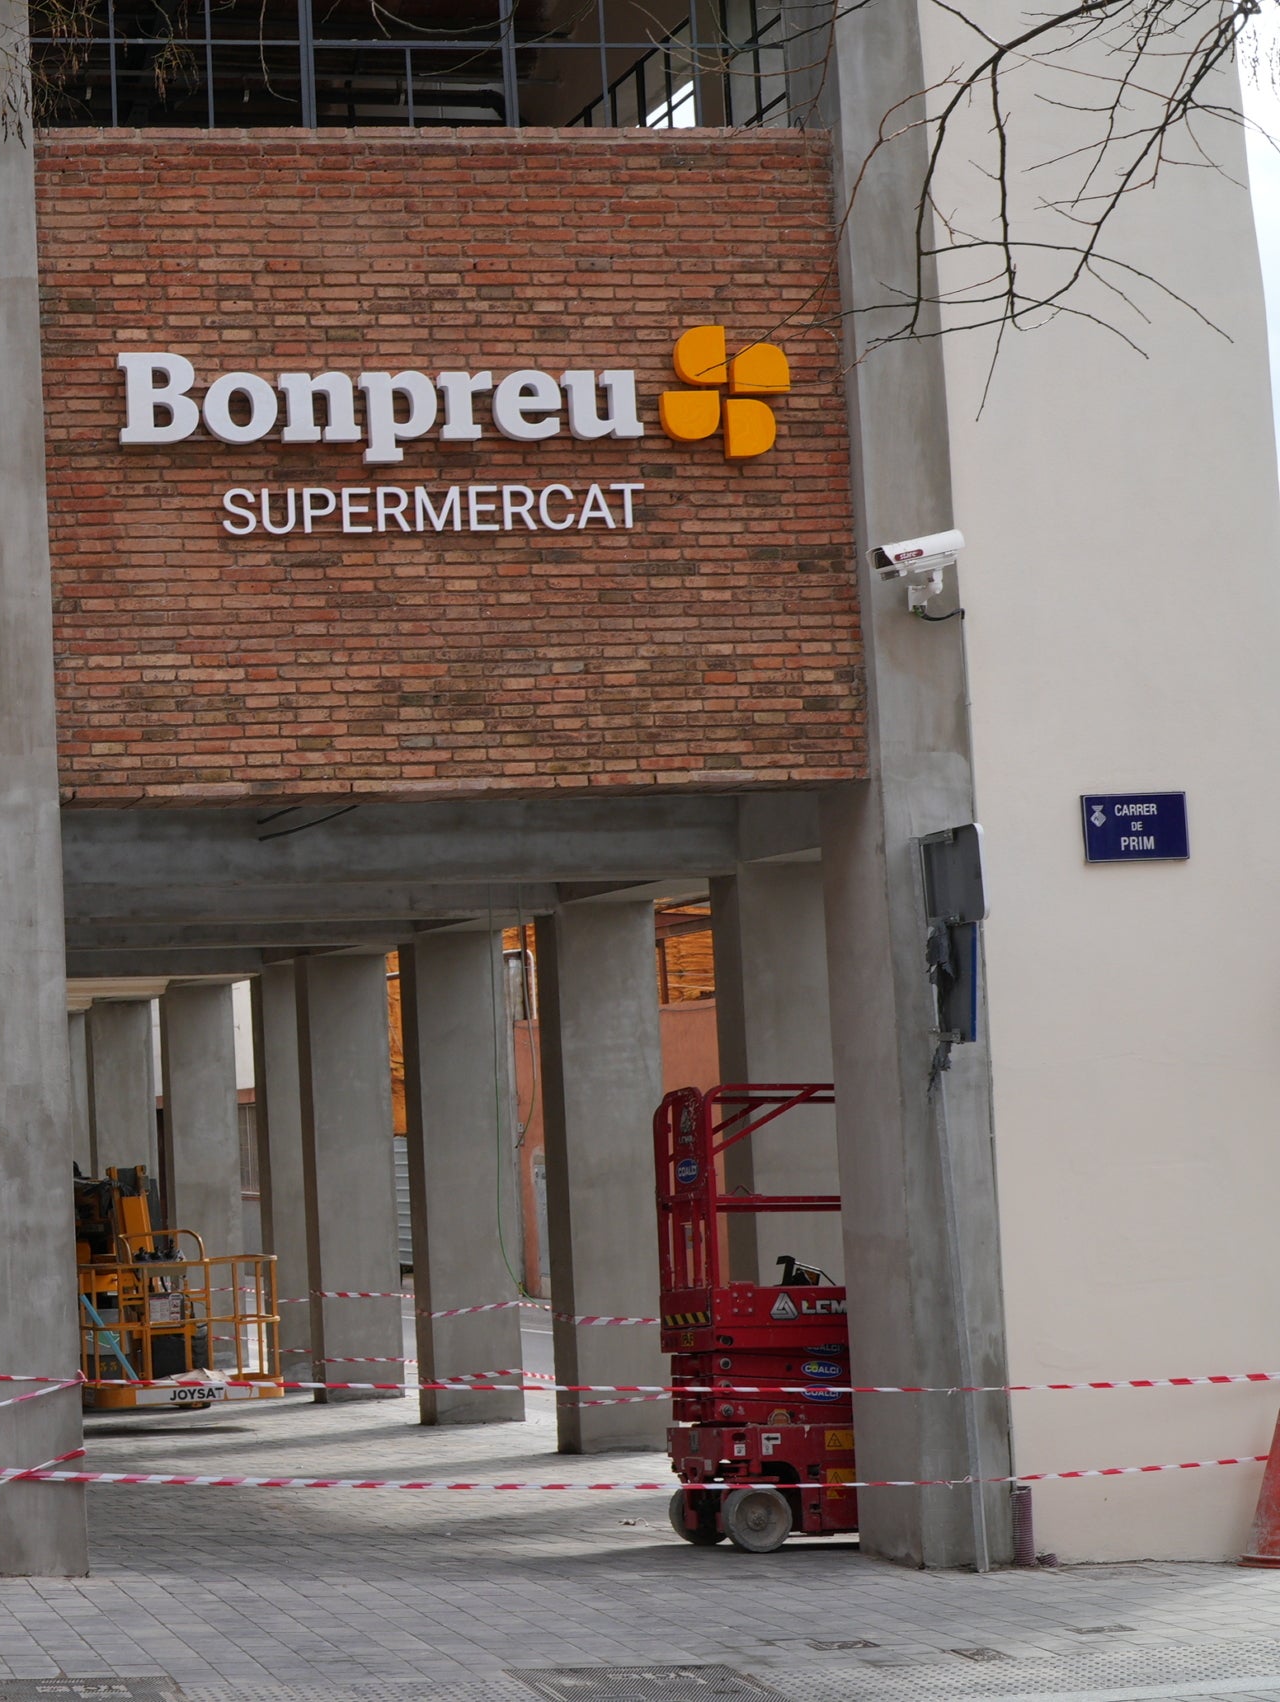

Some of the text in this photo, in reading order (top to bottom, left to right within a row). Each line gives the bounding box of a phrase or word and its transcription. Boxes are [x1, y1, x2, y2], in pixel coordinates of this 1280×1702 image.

[117, 351, 645, 464] Bonpreu
[221, 482, 645, 535] SUPERMERCAT
[1114, 803, 1158, 817] CARRER
[1131, 821, 1144, 831] DE
[1120, 836, 1155, 851] PRIM
[804, 1365, 839, 1374] COALCI
